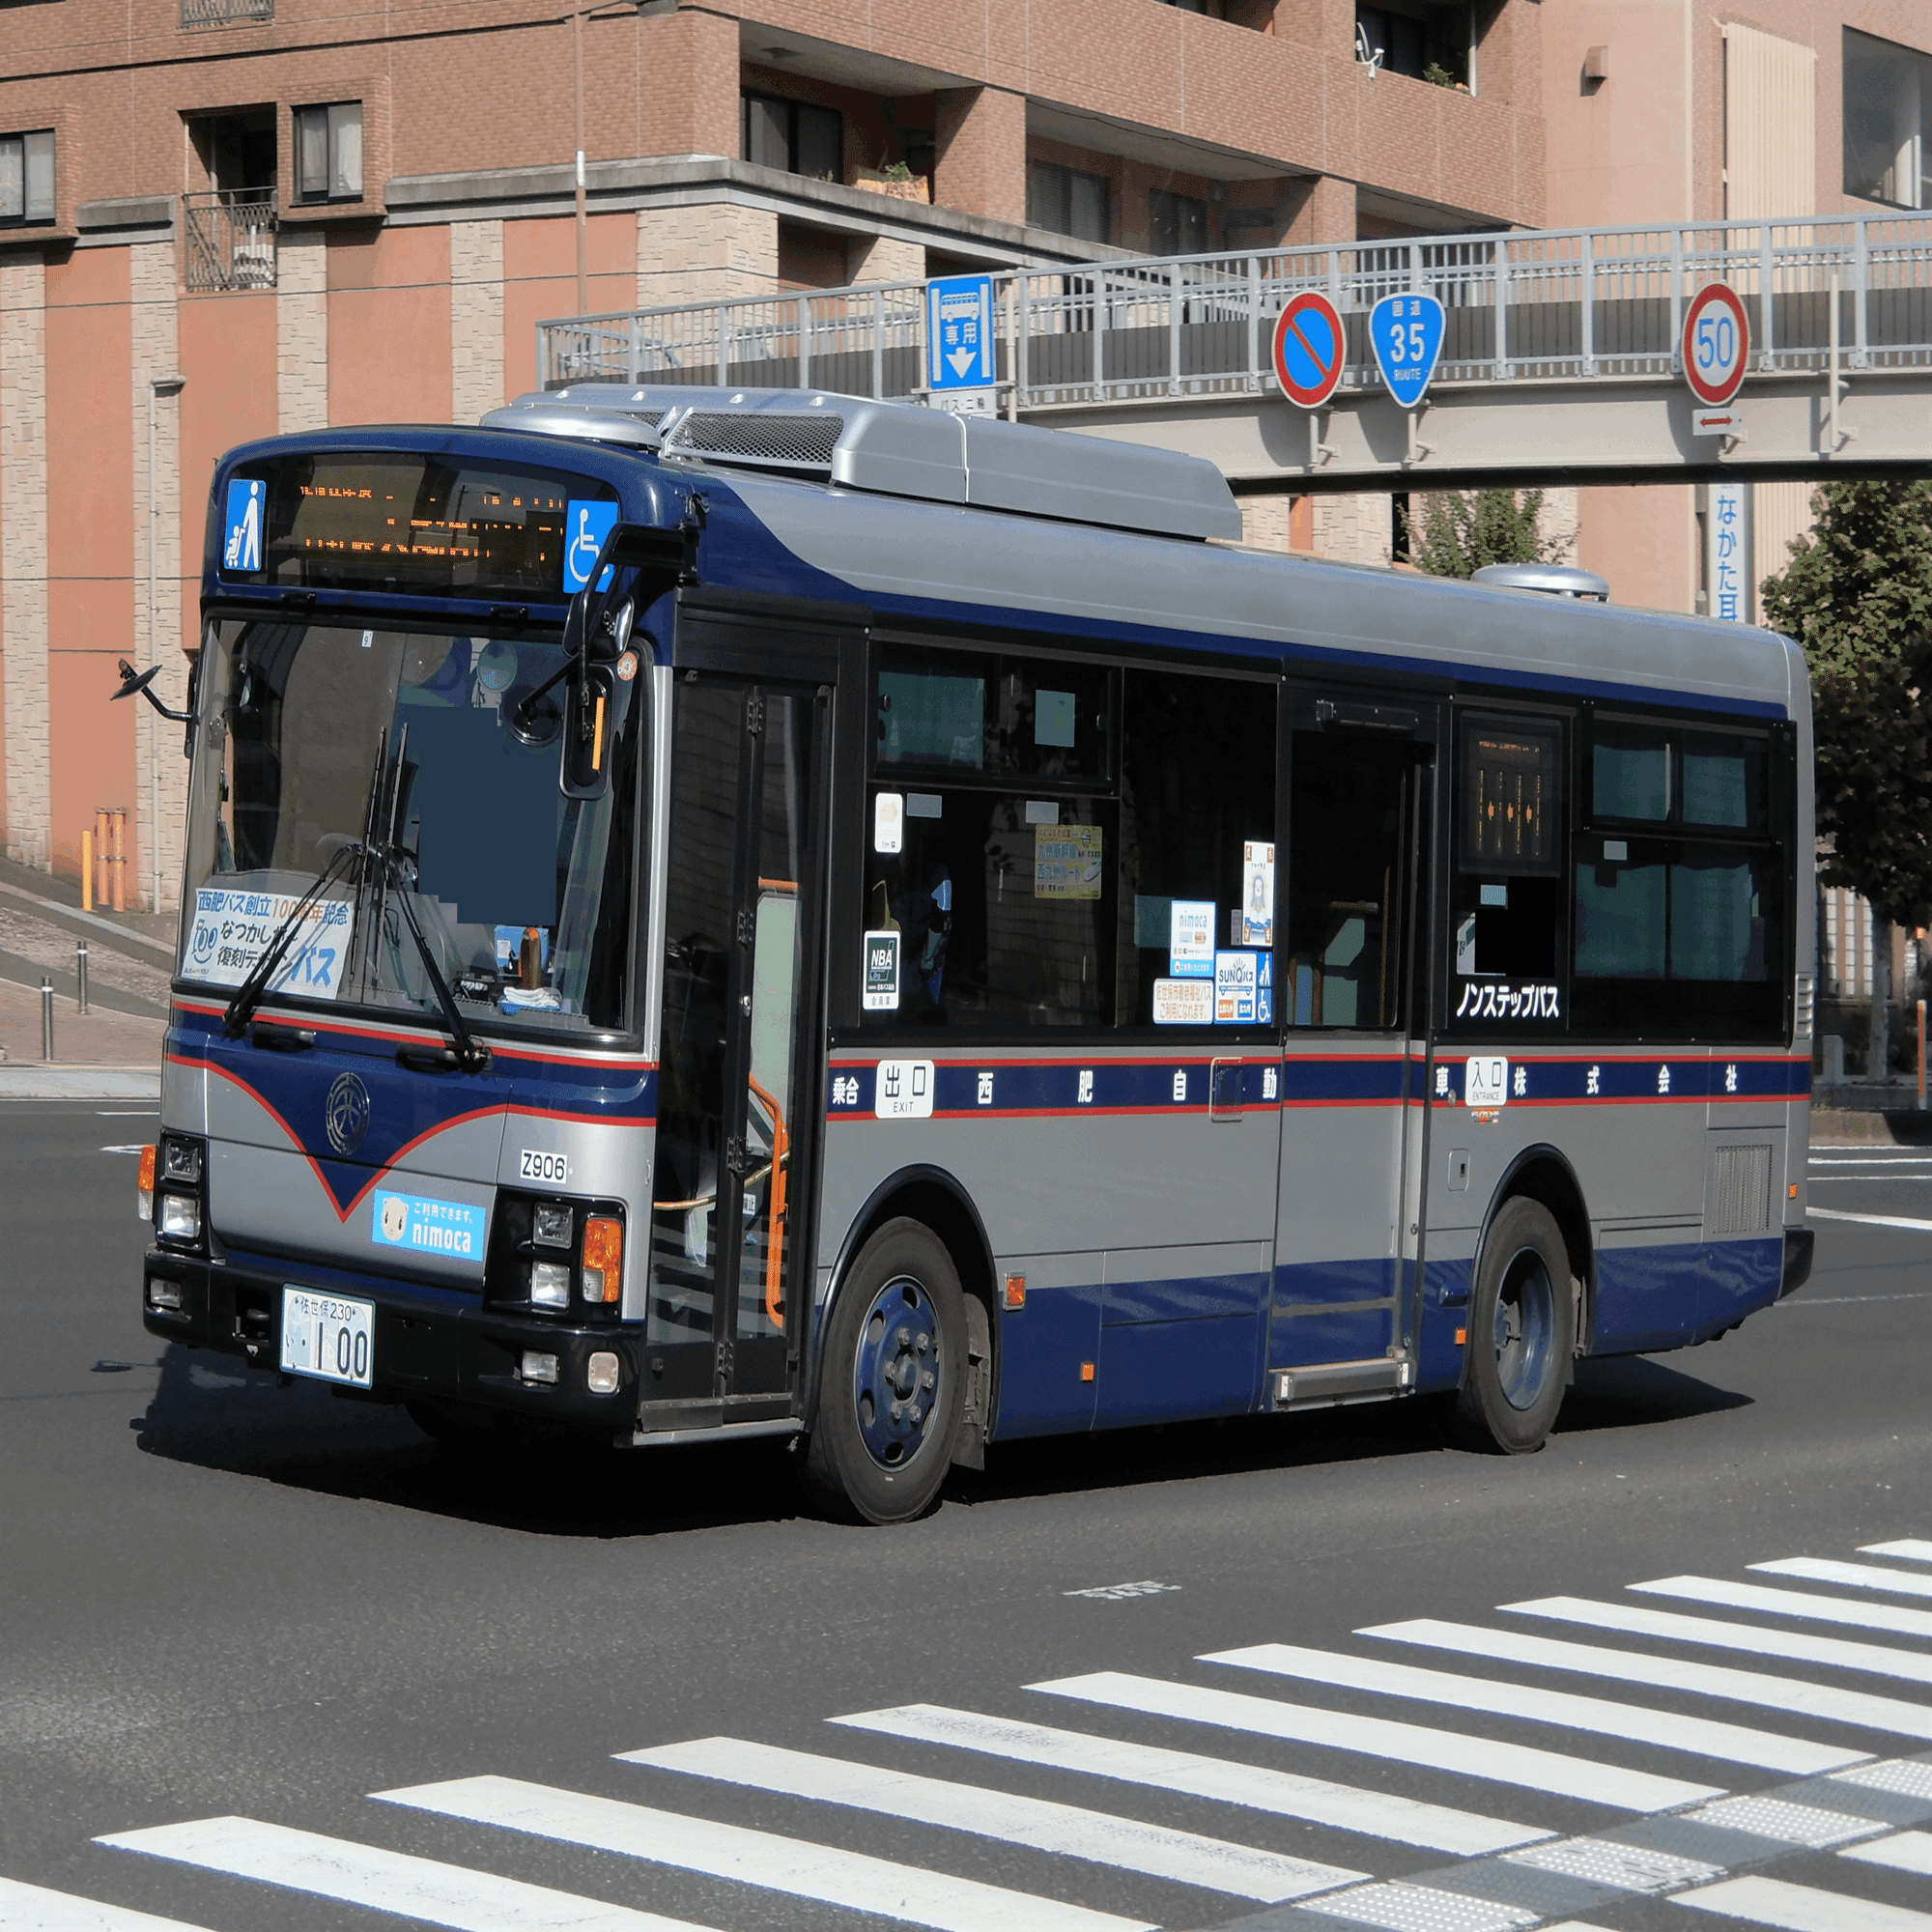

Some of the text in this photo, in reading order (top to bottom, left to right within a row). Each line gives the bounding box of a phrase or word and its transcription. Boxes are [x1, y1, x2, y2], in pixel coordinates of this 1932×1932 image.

[1391, 299, 1422, 317] 国道
[945, 322, 978, 345] 専用
[1390, 323, 1425, 362] 35
[1697, 317, 1732, 369] 50
[1393, 368, 1421, 382] ROUTE
[1179, 910, 1208, 927] nimoca
[871, 950, 893, 967] NBA
[1457, 983, 1559, 1018] ノンステップバス
[885, 1065, 926, 1097] 出口
[1471, 1062, 1501, 1088] 入口
[832, 1076, 860, 1105] 乗合
[1472, 1092, 1500, 1101] ENTRANCE
[893, 1101, 914, 1113] EXIT
[522, 1152, 565, 1181] Z906
[413, 1203, 473, 1225] ご利用できます。
[412, 1217, 471, 1254] nimoca
